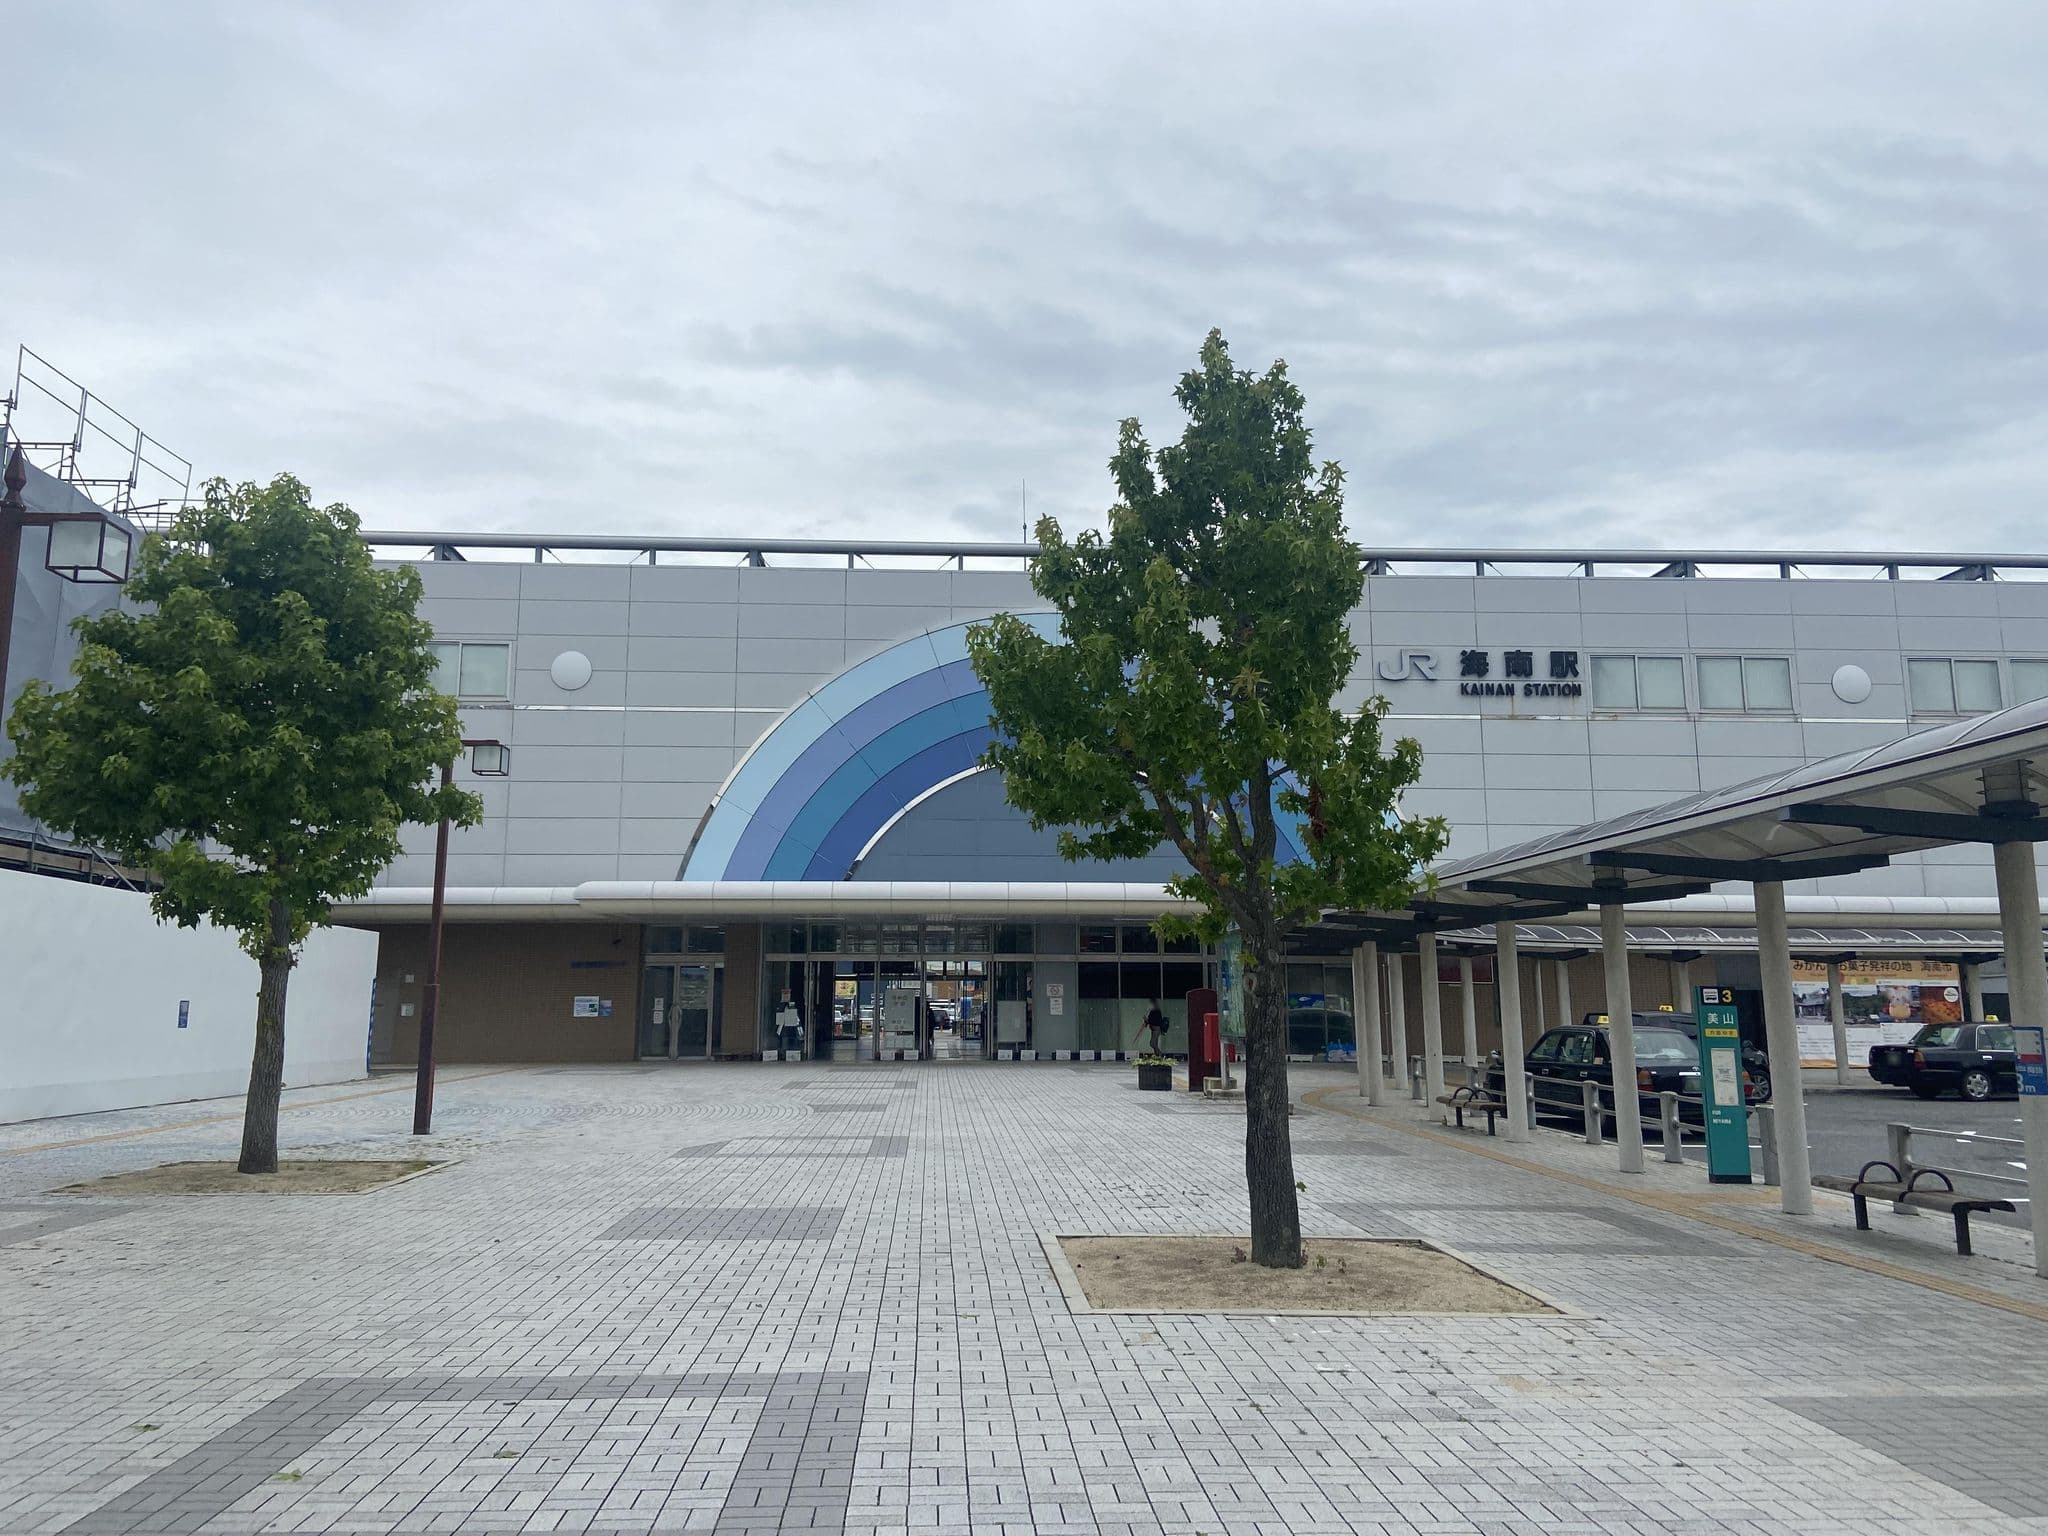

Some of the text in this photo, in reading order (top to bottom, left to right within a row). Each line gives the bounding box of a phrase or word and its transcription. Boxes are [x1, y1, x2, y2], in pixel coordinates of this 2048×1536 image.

[1378, 648, 1438, 681] JR
[1460, 649, 1580, 678] 海南駅
[1460, 682, 1582, 697] KAINAN STATION
[1792, 960, 1826, 971] みかん
[1722, 989, 1733, 1003] 3
[1707, 1012, 1734, 1025] 美山
